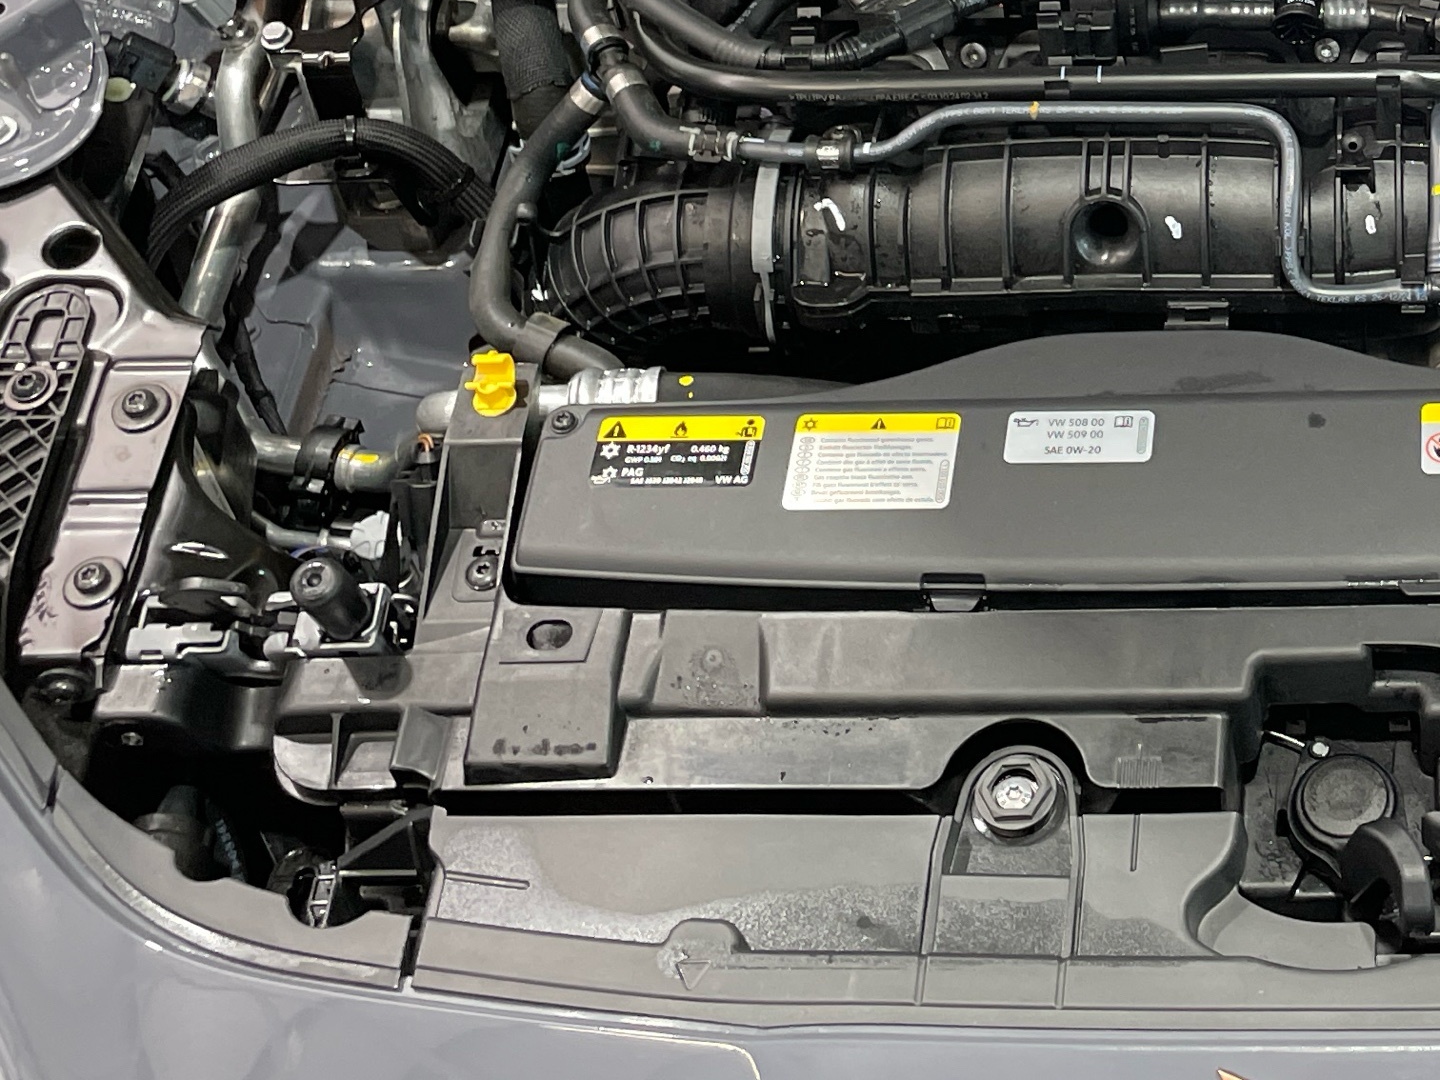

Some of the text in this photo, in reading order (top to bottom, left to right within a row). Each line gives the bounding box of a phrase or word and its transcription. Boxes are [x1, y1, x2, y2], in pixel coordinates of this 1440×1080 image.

[1048, 418, 1106, 427] VW 508 00
[1047, 430, 1104, 439] VW 509 00
[626, 444, 731, 455] R-1234yf 0.460 kg
[1044, 446, 1102, 455] SAE 0W-20
[621, 468, 645, 477] PAG
[715, 476, 749, 485] VW AG
